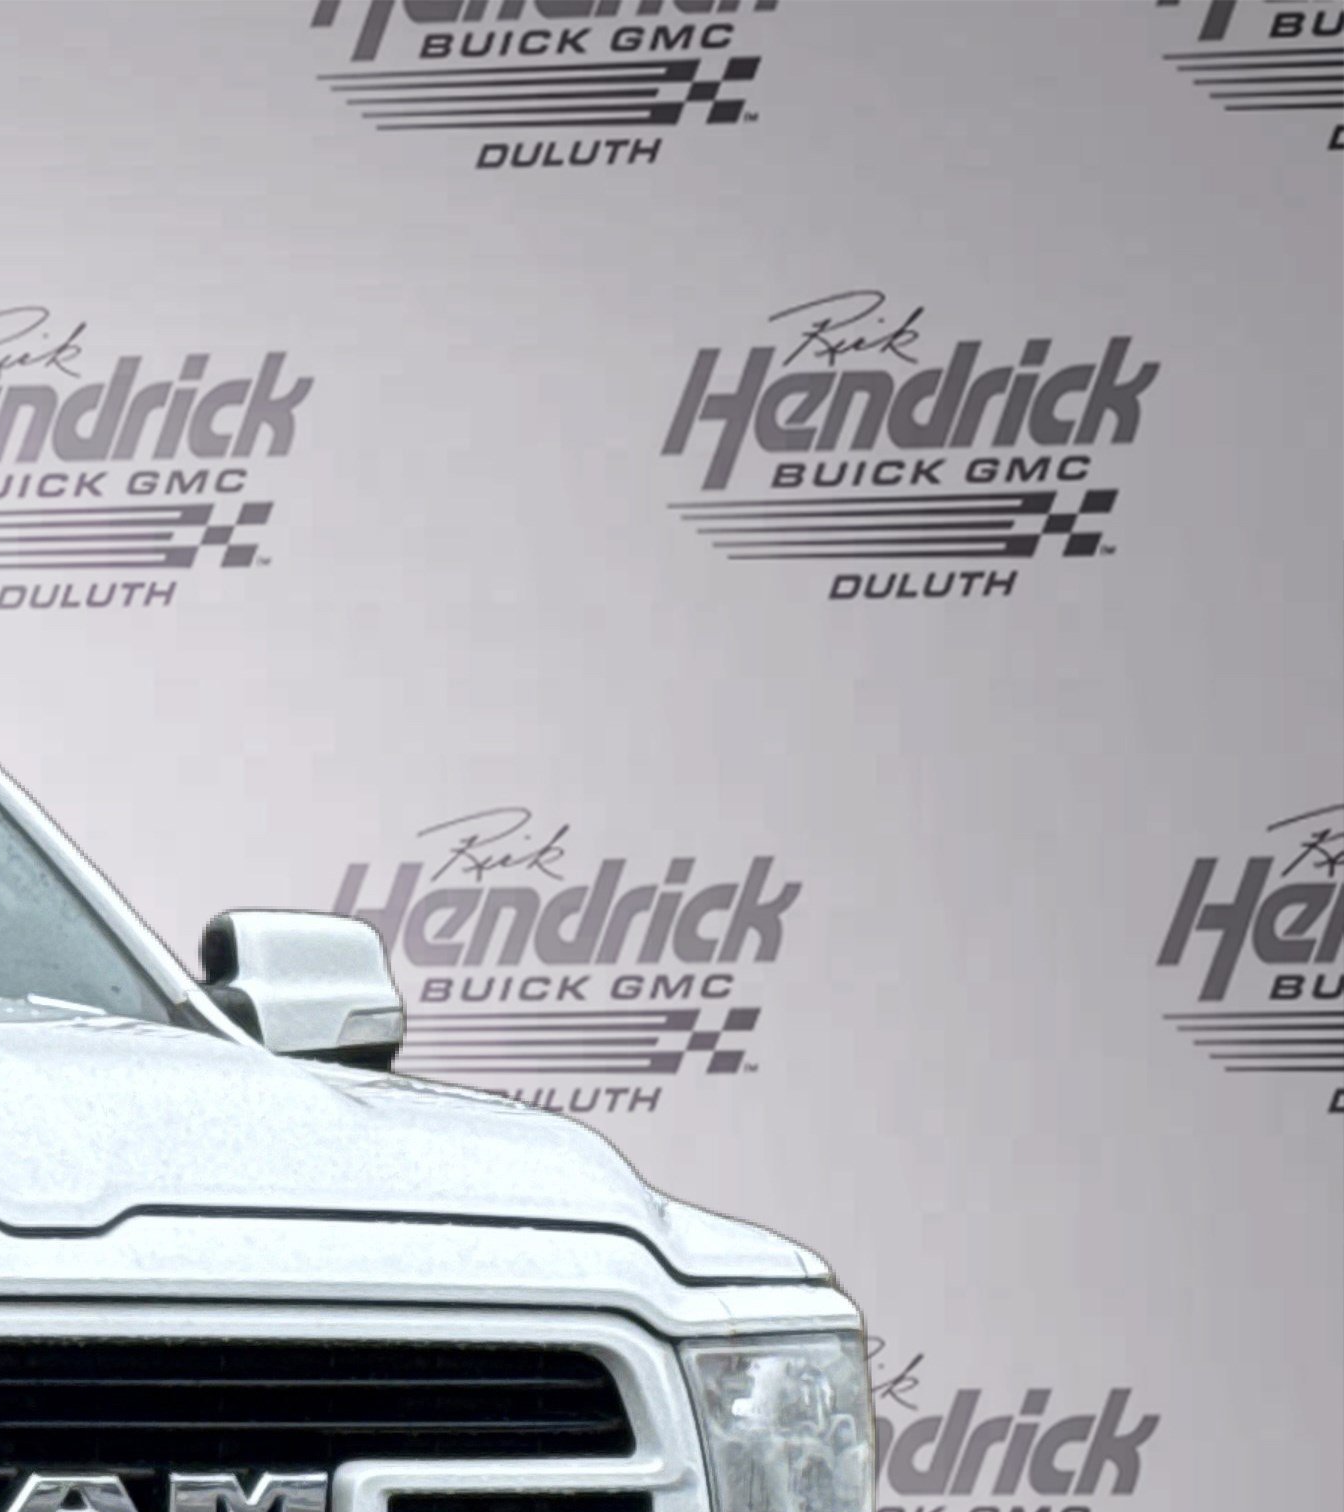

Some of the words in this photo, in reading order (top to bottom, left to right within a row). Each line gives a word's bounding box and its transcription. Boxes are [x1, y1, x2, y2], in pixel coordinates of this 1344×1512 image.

[419, 27, 592, 59] BUICK
[610, 23, 735, 52] GMC
[475, 138, 662, 169] DULUTH
[660, 336, 1161, 491] Hendrick
[126, 468, 248, 496] GMC
[770, 458, 946, 489] BUICK
[964, 455, 1091, 484] GMC
[829, 570, 1018, 600] DULUTH
[419, 974, 591, 1003] BUICK
[609, 973, 734, 1001] GMC
[876, 1387, 1161, 1496] drick
